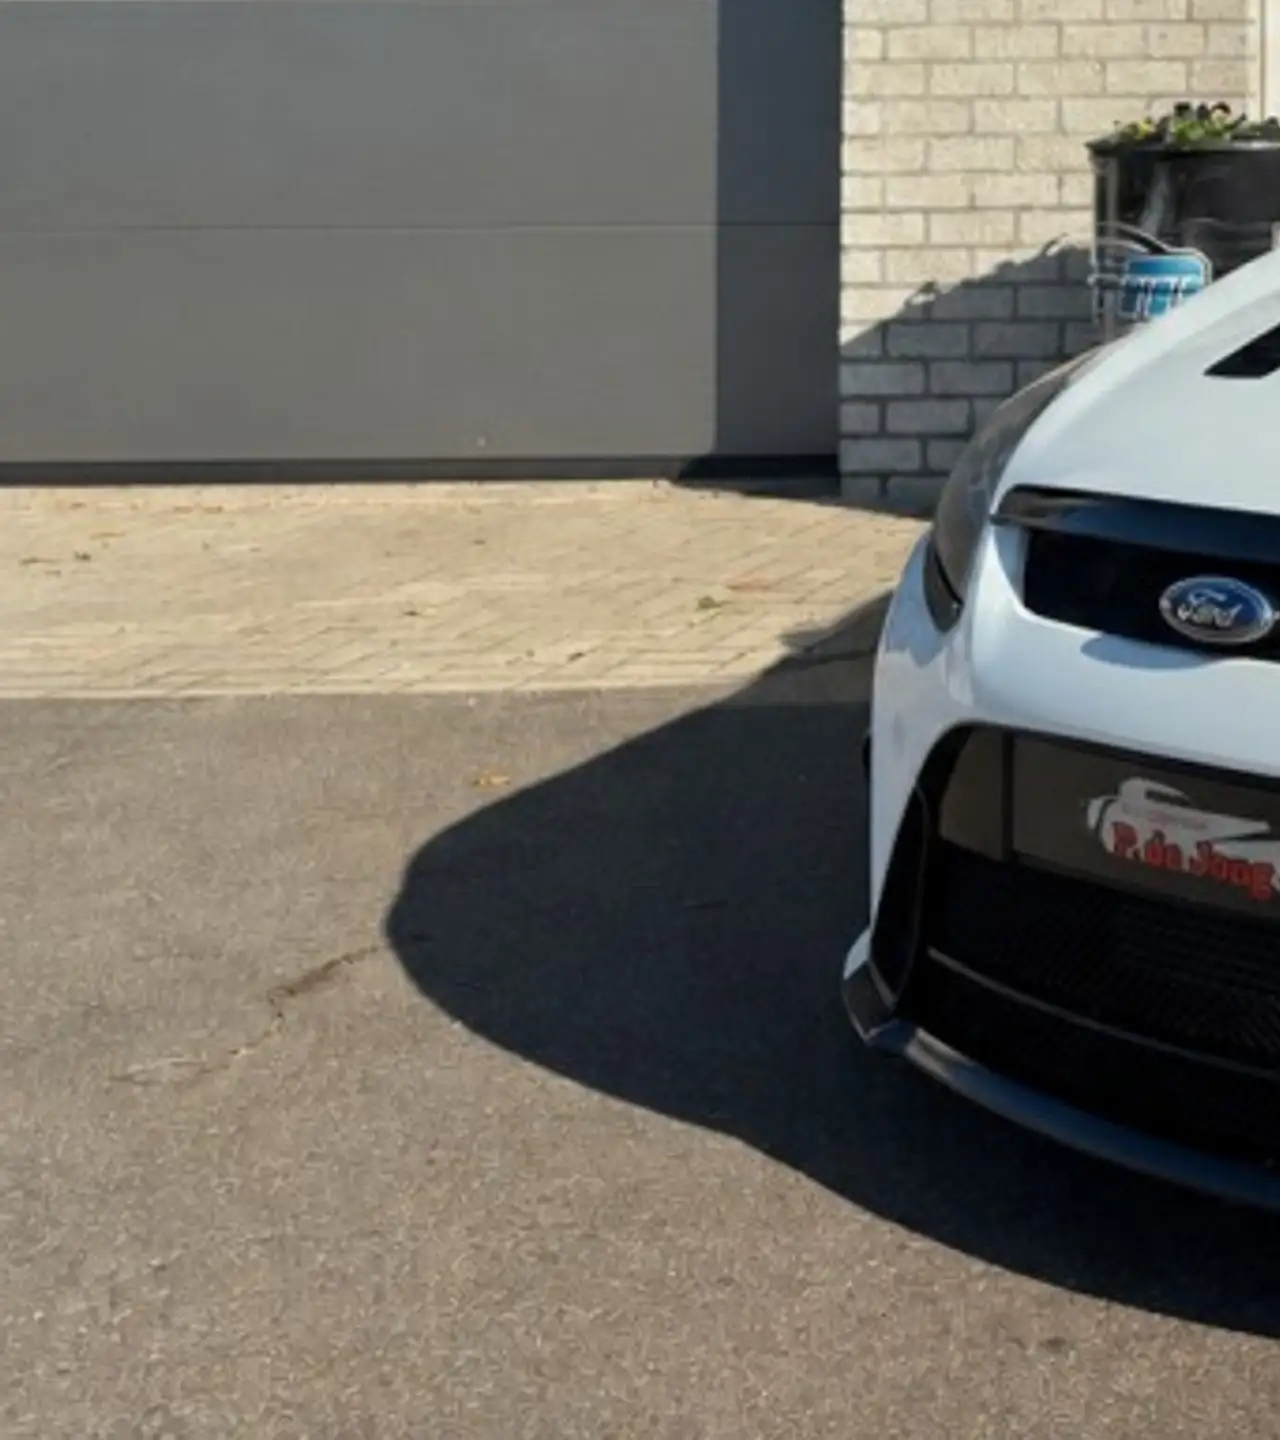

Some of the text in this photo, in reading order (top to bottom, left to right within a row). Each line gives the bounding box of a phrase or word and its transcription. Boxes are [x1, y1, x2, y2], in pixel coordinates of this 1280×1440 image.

[1176, 587, 1243, 628] Ford
[1112, 820, 1276, 902] P. de Jong
